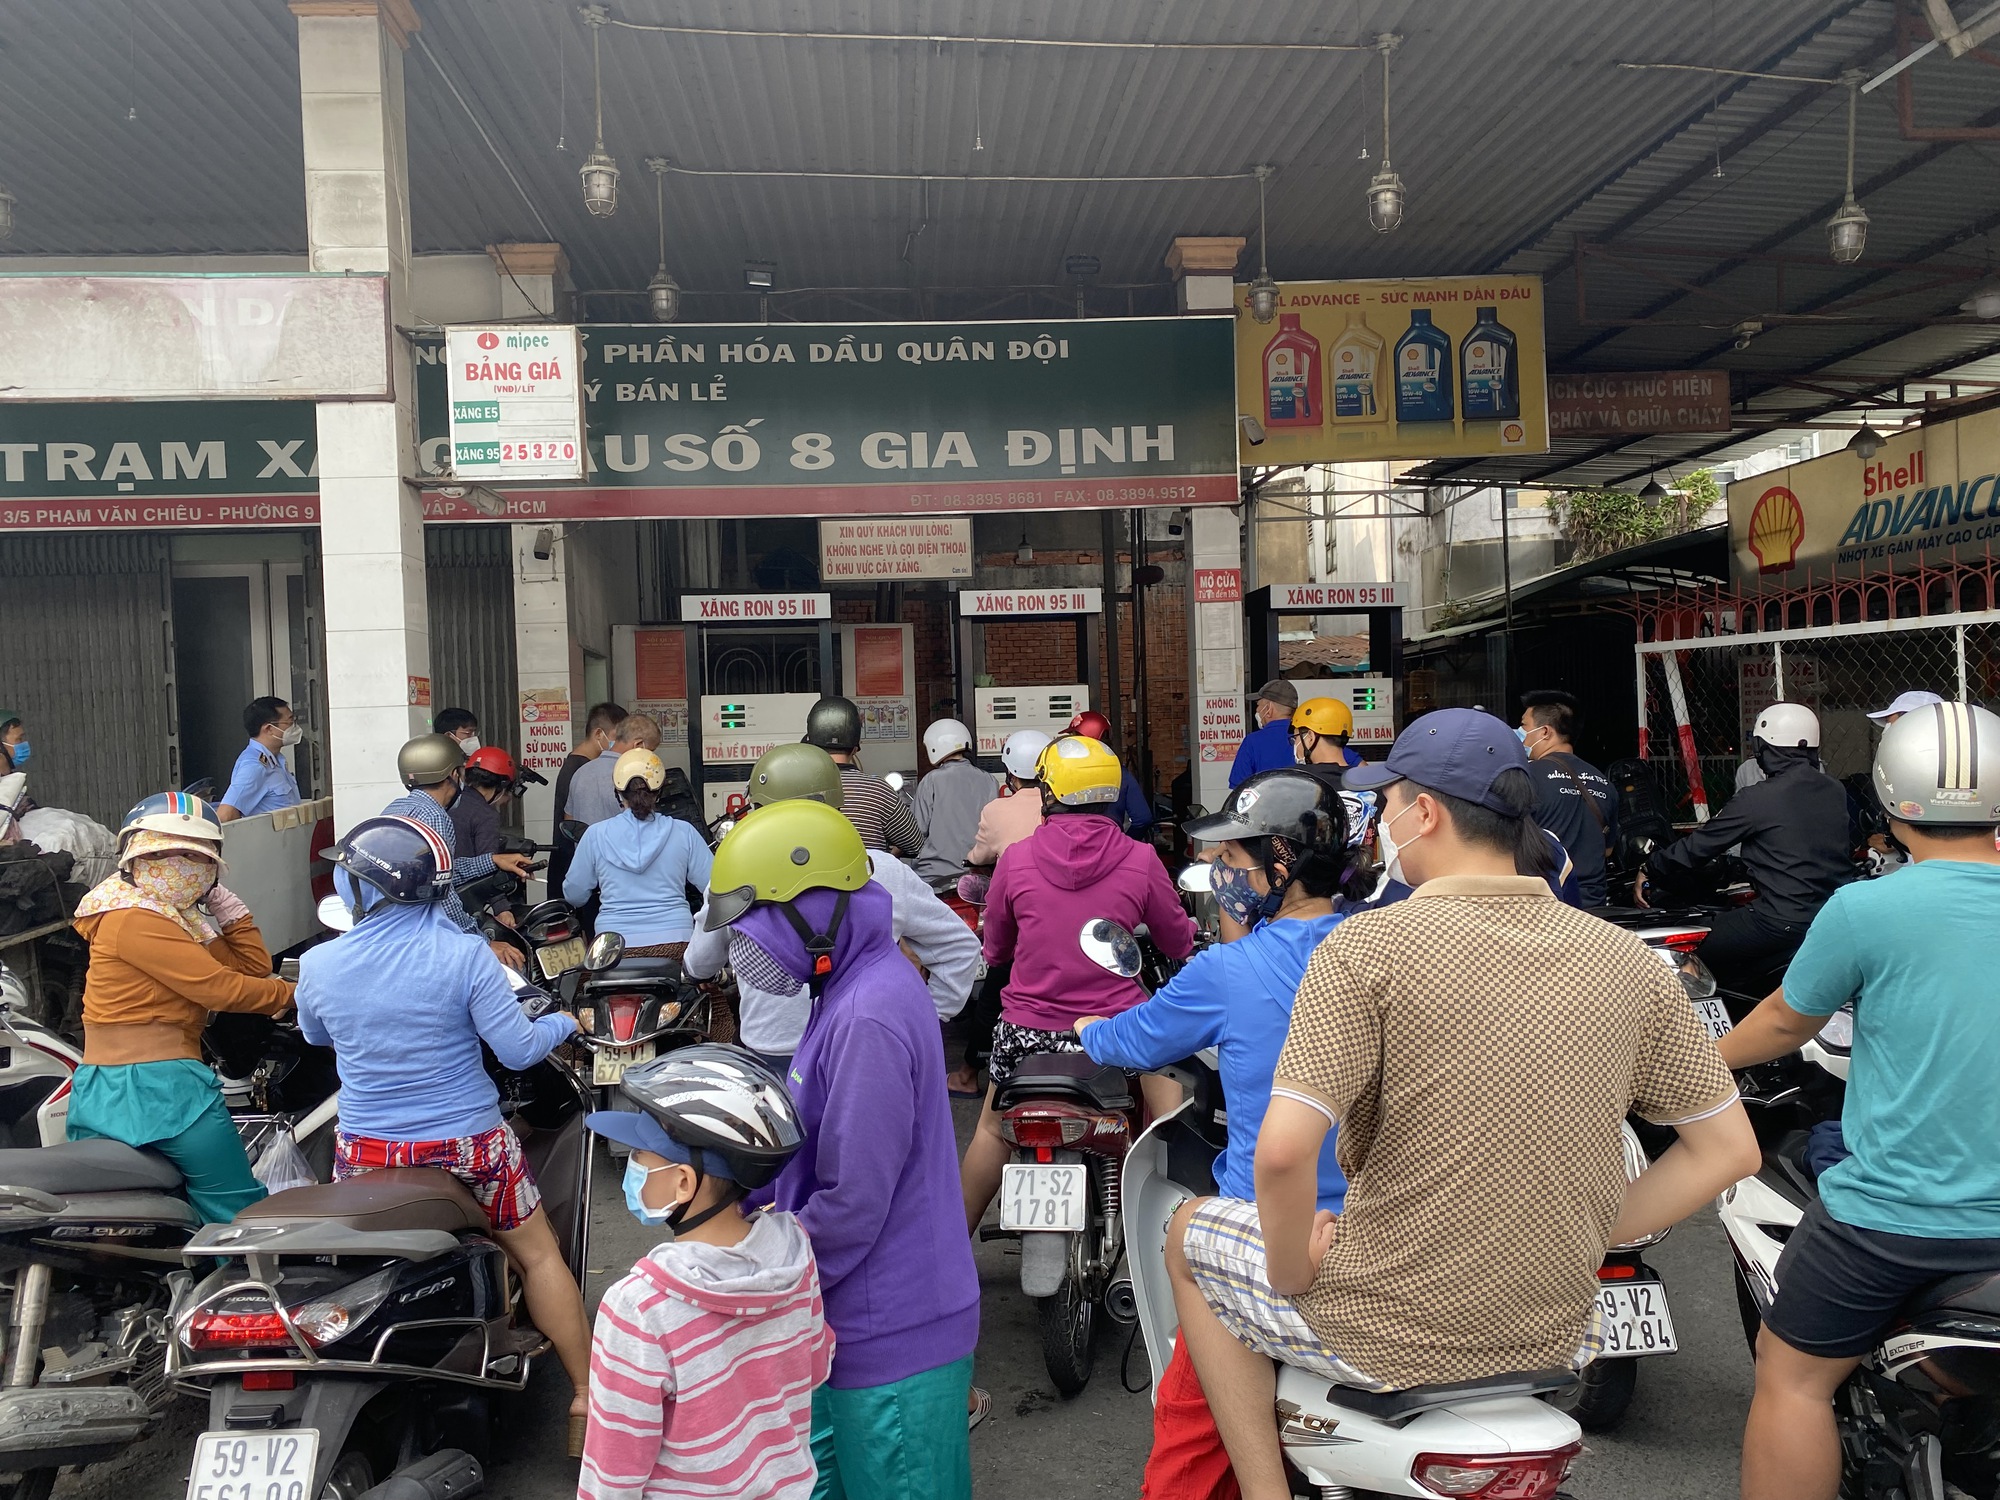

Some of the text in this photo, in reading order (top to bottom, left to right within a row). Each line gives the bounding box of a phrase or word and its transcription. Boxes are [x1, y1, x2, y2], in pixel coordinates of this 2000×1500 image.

[1291, 293, 1360, 307] ADVANCE
[1413, 290, 1458, 304] MẠNH
[507, 332, 549, 351] mipec
[603, 334, 705, 364] PHẦN
[719, 336, 796, 363] HÓA
[809, 334, 884, 363] DẦU
[897, 335, 995, 364] QUÂN
[1007, 334, 1069, 364] ĐỘI
[465, 355, 522, 381] BẢNG
[528, 357, 562, 380] GIÁ
[1402, 370, 1437, 378] ADVANCE
[616, 377, 679, 402] BÁN
[691, 374, 727, 401] LẺ
[1623, 376, 1667, 403] THỰC
[1672, 375, 1713, 401] HIỆN
[454, 406, 498, 420] XĂNG E5
[1550, 403, 1722, 429] CHÁY VÀ CHỮA CHÁY
[456, 443, 574, 461] XĂNG 95 25320
[663, 418, 765, 472] SỐ
[789, 432, 836, 471] 8
[860, 431, 979, 470] GIA
[1004, 425, 1175, 474] ĐỊNH
[0, 440, 231, 491] TRẠM
[1864, 450, 1924, 497] Shell
[943, 493, 1002, 506] 08.3895
[1054, 490, 1091, 502] FAX:
[36, 509, 91, 525] PHẠM
[97, 505, 137, 523] VĂN
[143, 504, 202, 522] CHIÊU
[219, 503, 299, 520] PHƯỜNG
[304, 507, 315, 520] 9
[839, 521, 953, 538] XIN QUÝ KHÁCH VUI LÒNG!
[826, 540, 966, 558] KHÔNG NGHE VÀ GỌI ĐIỆN THOẠI
[1871, 545, 1884, 559] XE
[1946, 530, 1972, 545] CAO
[827, 558, 833, 575] Ở
[835, 562, 854, 575] KHU
[857, 560, 874, 577] VỰC
[876, 559, 893, 574] CÂY
[1200, 570, 1236, 588] MỞ CỬA
[976, 593, 1013, 612] XĂNG
[1018, 595, 1045, 611] RON
[1050, 594, 1067, 610] 95
[1287, 586, 1323, 605] XĂNG
[1328, 588, 1355, 604] RON
[1360, 588, 1377, 603] 95
[700, 598, 739, 617] XĂNG
[744, 600, 773, 616] RON
[778, 599, 797, 616] 95
[986, 704, 993, 713] 3
[1074, 702, 1081, 711] 2
[1385, 695, 1390, 704] 1
[713, 713, 719, 722] 4
[1202, 711, 1240, 727] SỬ DỤNG
[1200, 728, 1244, 743] ĐIỆN THOẠI
[1357, 725, 1392, 739] KHI BÁN
[526, 739, 567, 755] SỬ DỤNG
[706, 742, 724, 758] TRẢ
[727, 742, 739, 758] VỀ
[980, 734, 997, 750] TRẢ
[523, 755, 567, 770] ĐIỆN THO
[604, 1043, 644, 1062] 59-V1
[1015, 1169, 1073, 1196] 71-S2
[1013, 1199, 1069, 1225] 1781
[1601, 1319, 1670, 1351] 92.84
[212, 1438, 298, 1478] 59-V2
